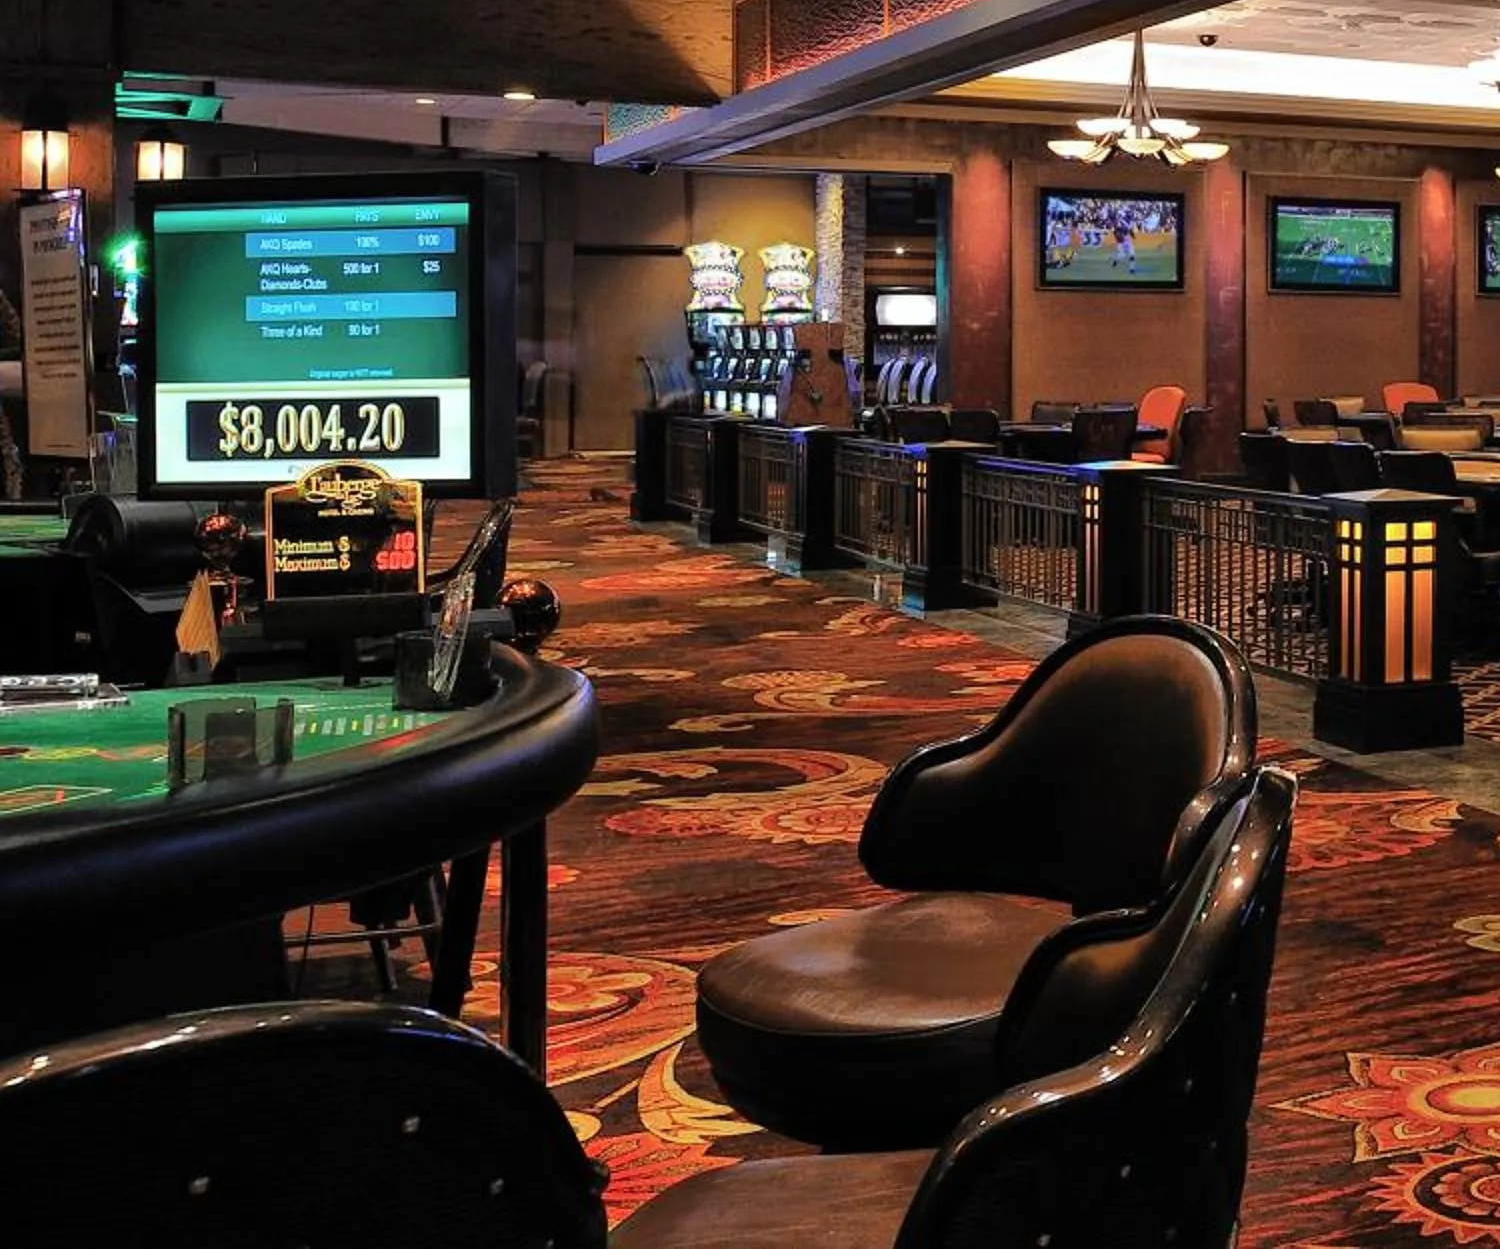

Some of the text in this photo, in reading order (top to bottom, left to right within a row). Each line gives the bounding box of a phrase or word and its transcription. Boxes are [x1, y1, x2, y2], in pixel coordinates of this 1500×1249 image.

[218, 402, 405, 458] $8,004.20
[274, 539, 334, 554] Minimum
[394, 531, 415, 550] 10
[274, 557, 339, 572] Maximum
